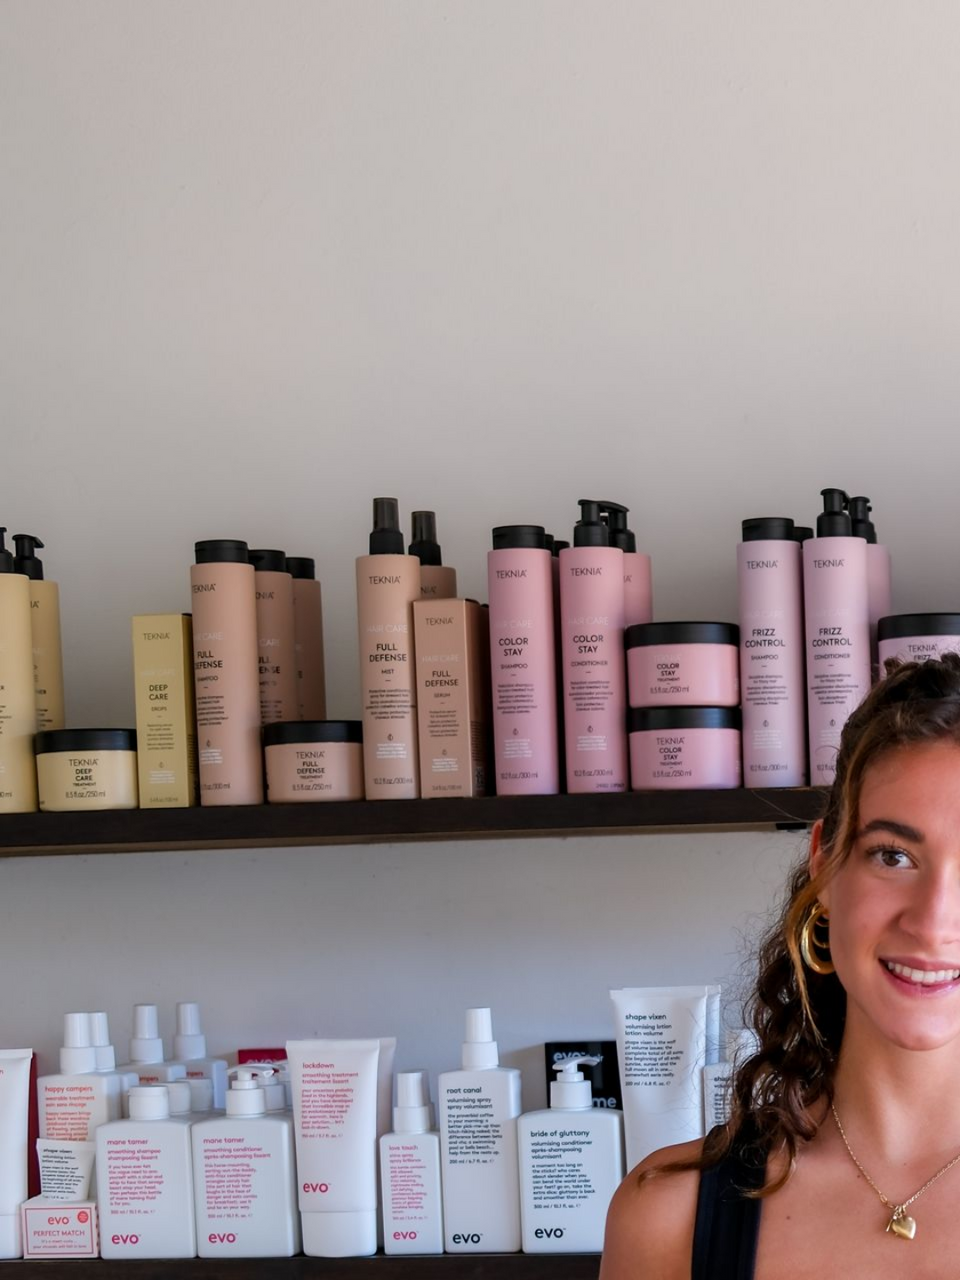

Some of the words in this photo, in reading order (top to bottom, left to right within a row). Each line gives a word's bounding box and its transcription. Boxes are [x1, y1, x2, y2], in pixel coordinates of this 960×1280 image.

[746, 560, 778, 570] TEKNIA
[813, 559, 845, 569] TEKNIA
[752, 628, 775, 637] FRIZZ
[819, 627, 842, 636] FRIZZ
[498, 638, 528, 646] COLOR
[573, 635, 603, 643] COLOR
[745, 638, 786, 648] CONTROL
[812, 637, 852, 647] CONTROL
[376, 643, 398, 651] FULL
[578, 646, 598, 654] STAY
[503, 648, 523, 656] STAY
[369, 654, 407, 662] DEFENSE
[432, 670, 451, 678] FULL
[425, 679, 459, 687] DEFENSE
[625, 1014, 647, 1022] shape
[531, 1130, 548, 1138] bride
[550, 1130, 558, 1138] of
[559, 1130, 590, 1138] gluttony
[303, 1182, 329, 1193] evo
[48, 1216, 70, 1225] evo
[393, 1231, 417, 1240] evo
[535, 1228, 563, 1238] evo
[112, 1234, 139, 1245] evo
[208, 1233, 236, 1244] evo
[453, 1234, 480, 1244] evo
